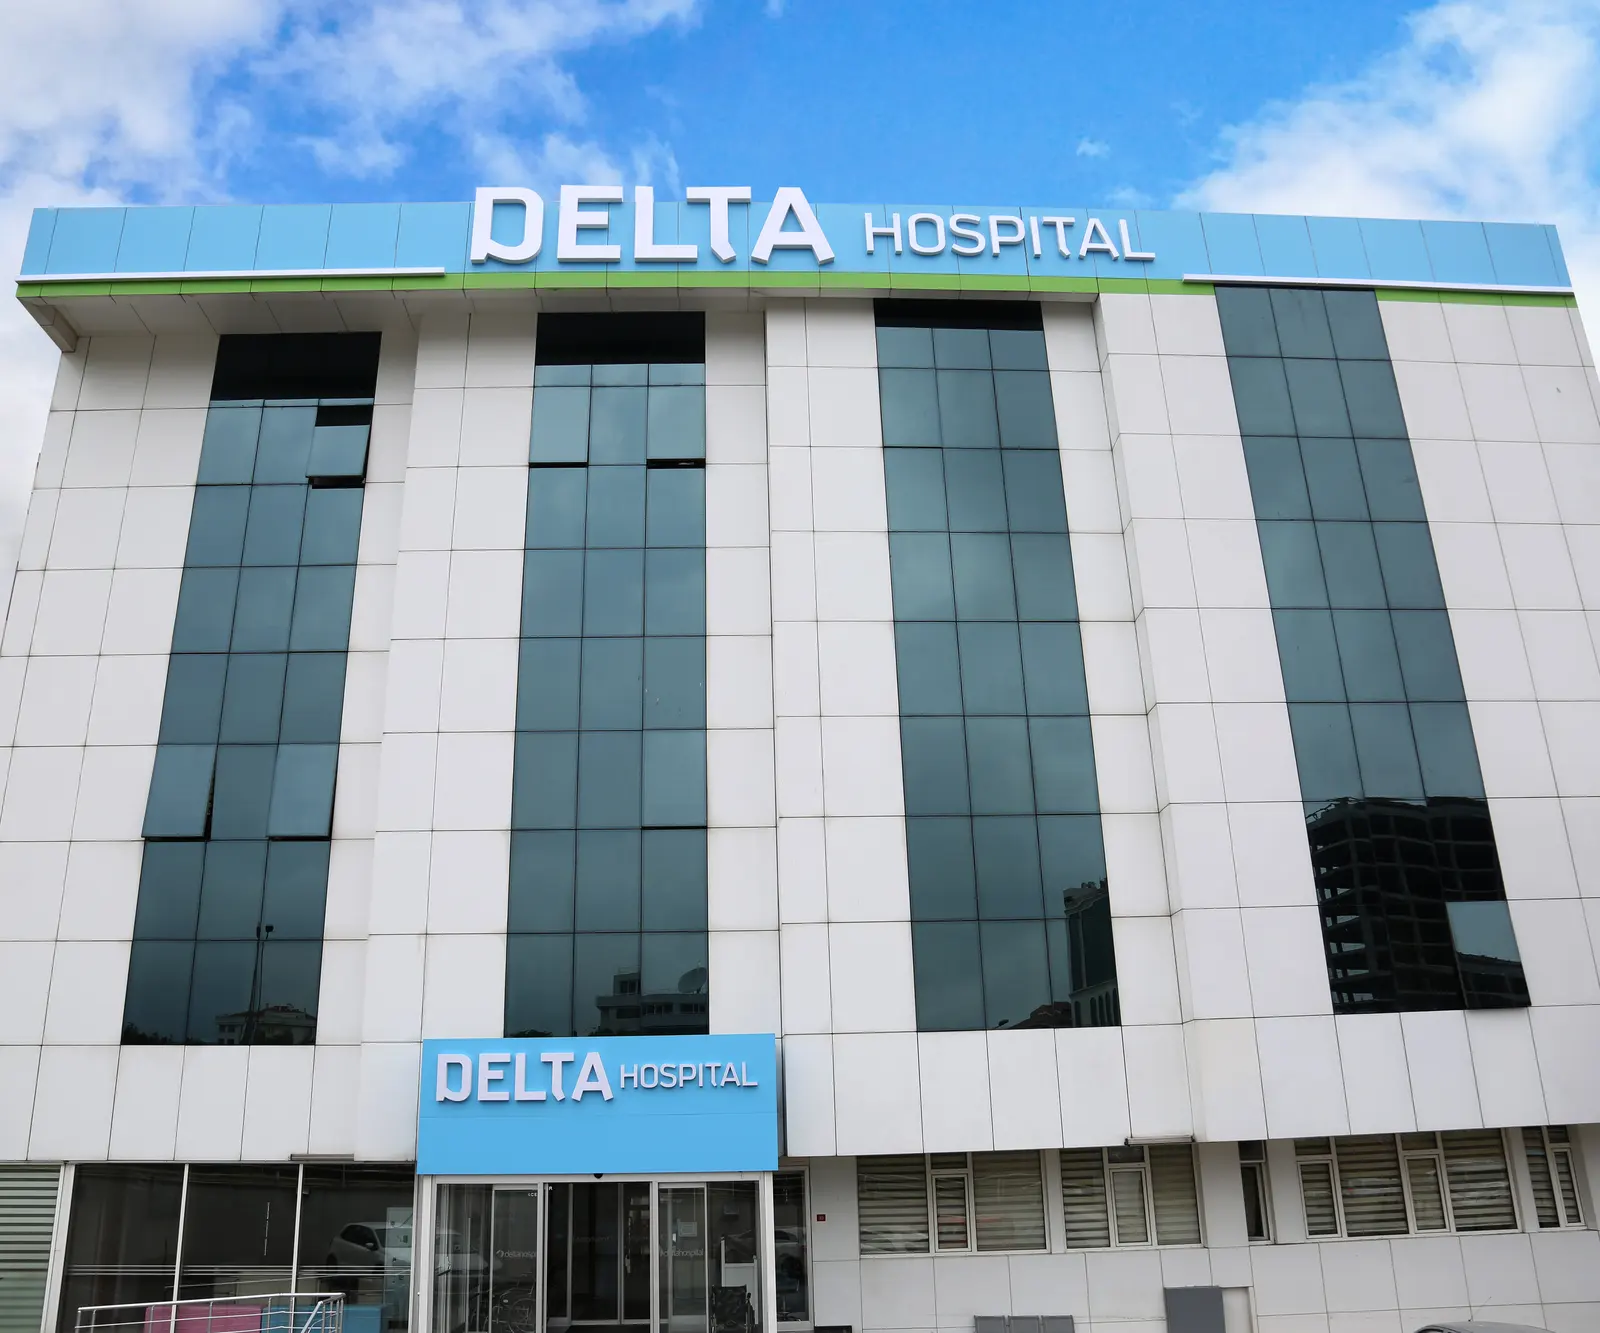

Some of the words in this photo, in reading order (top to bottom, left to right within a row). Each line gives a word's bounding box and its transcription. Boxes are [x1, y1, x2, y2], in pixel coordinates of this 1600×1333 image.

[470, 185, 834, 265] DELTA
[864, 212, 1155, 261] HOSPITAL
[436, 1052, 614, 1101] DELTA
[620, 1062, 758, 1088] HOSPITAL
